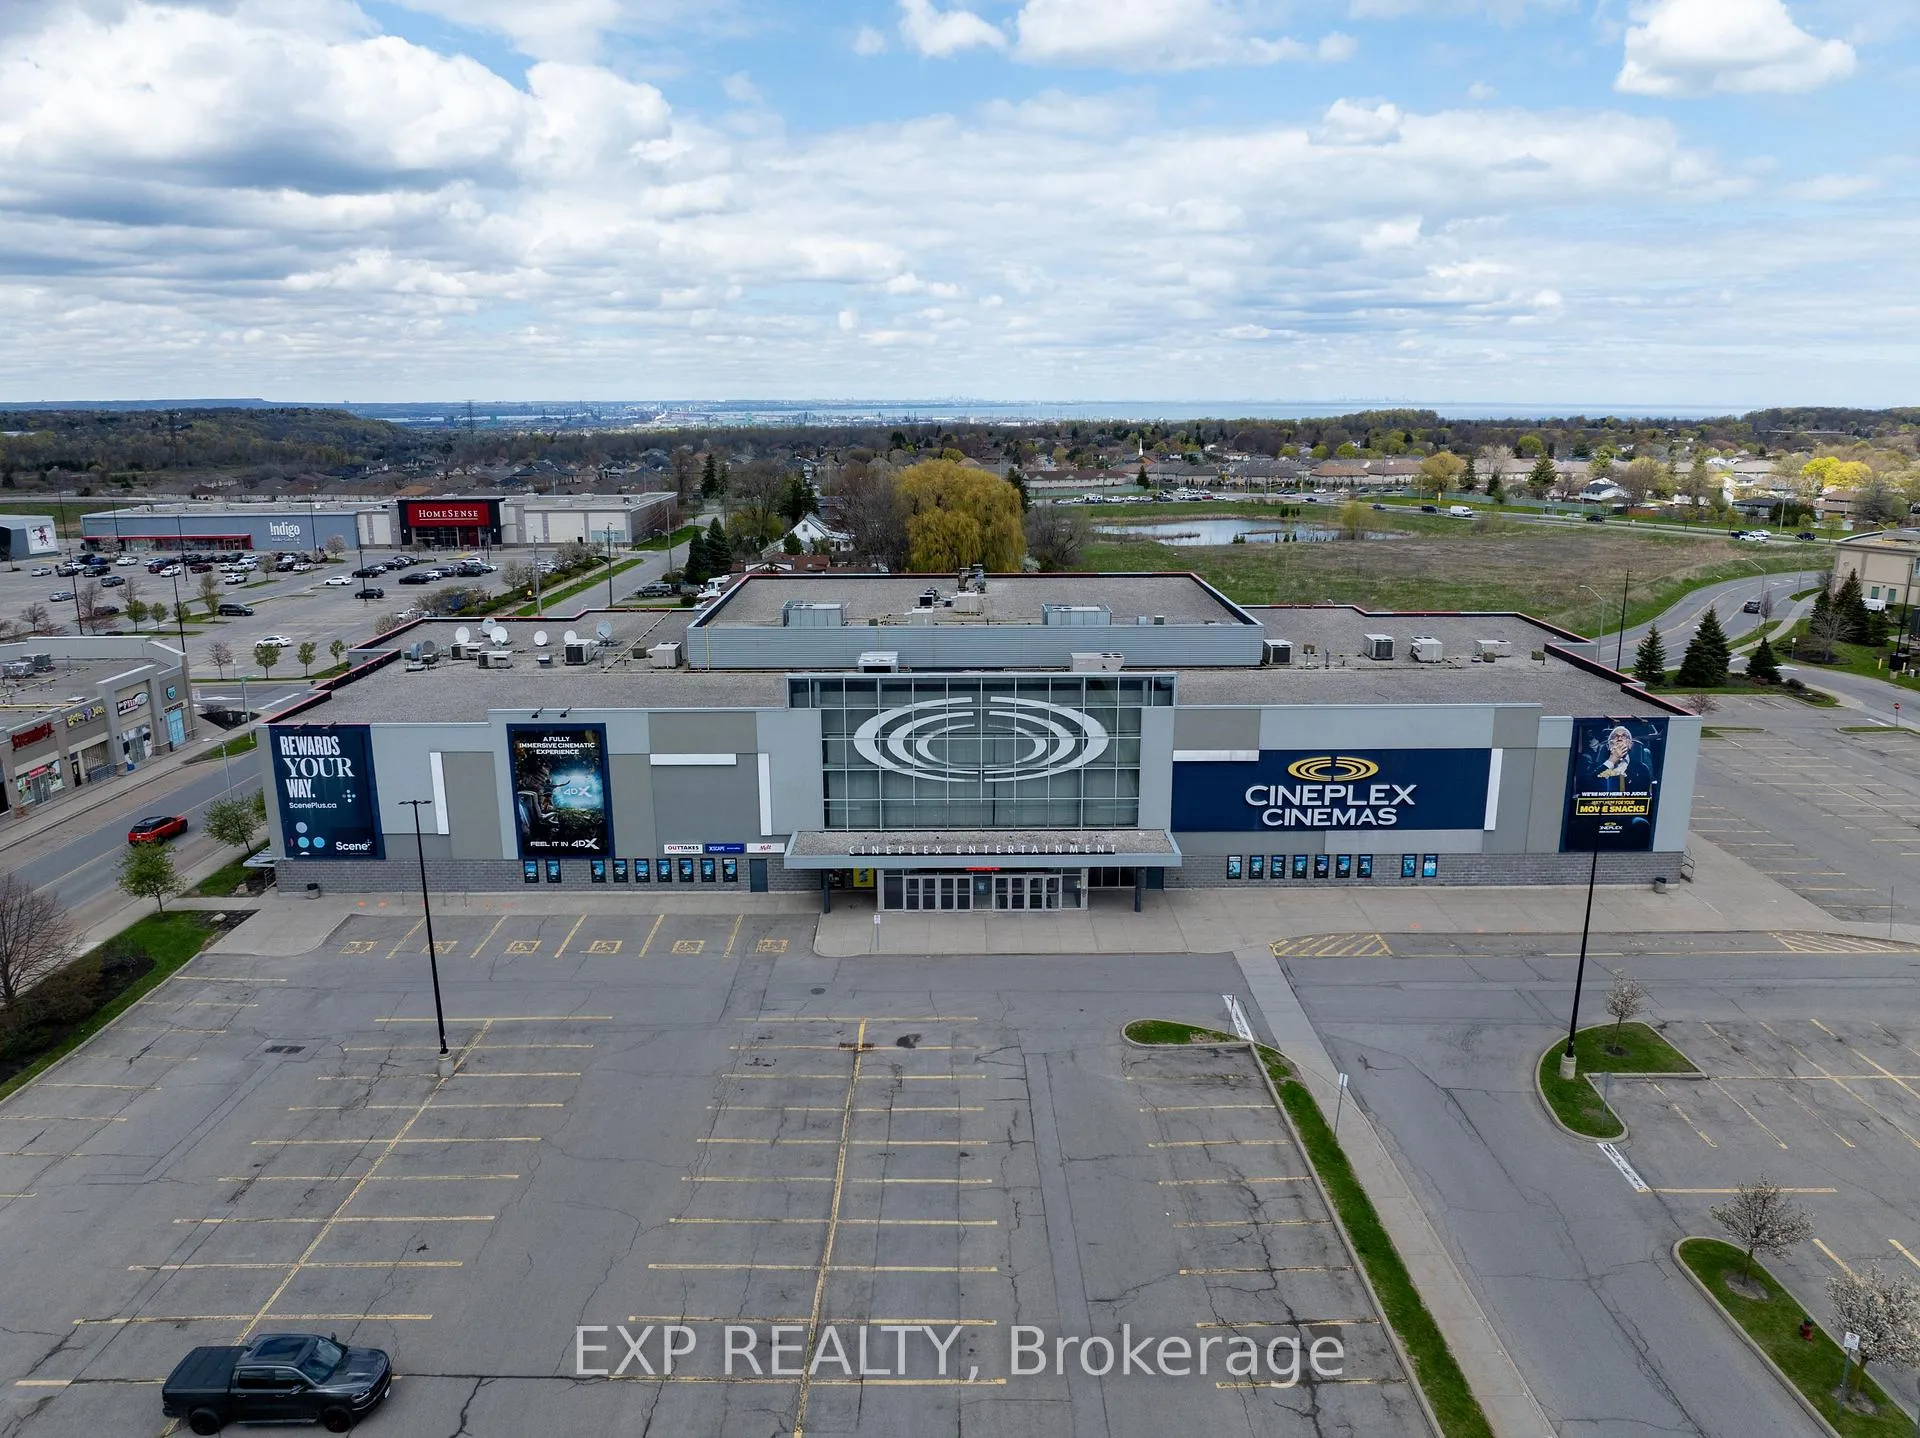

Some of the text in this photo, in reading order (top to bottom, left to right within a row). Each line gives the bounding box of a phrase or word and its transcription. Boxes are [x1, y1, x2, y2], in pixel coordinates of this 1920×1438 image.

[279, 735, 341, 756] REWARDS
[283, 757, 355, 778] YOUR
[286, 778, 317, 798] WAY.
[563, 787, 592, 798] 4DX
[1245, 784, 1417, 806] CINEPLEX
[1262, 808, 1397, 826] CINEMAS
[1579, 805, 1645, 813] MOVE SNACKS
[571, 837, 600, 850] 4DX
[849, 844, 1118, 855] CINEPLEX ENTERTAINMENT
